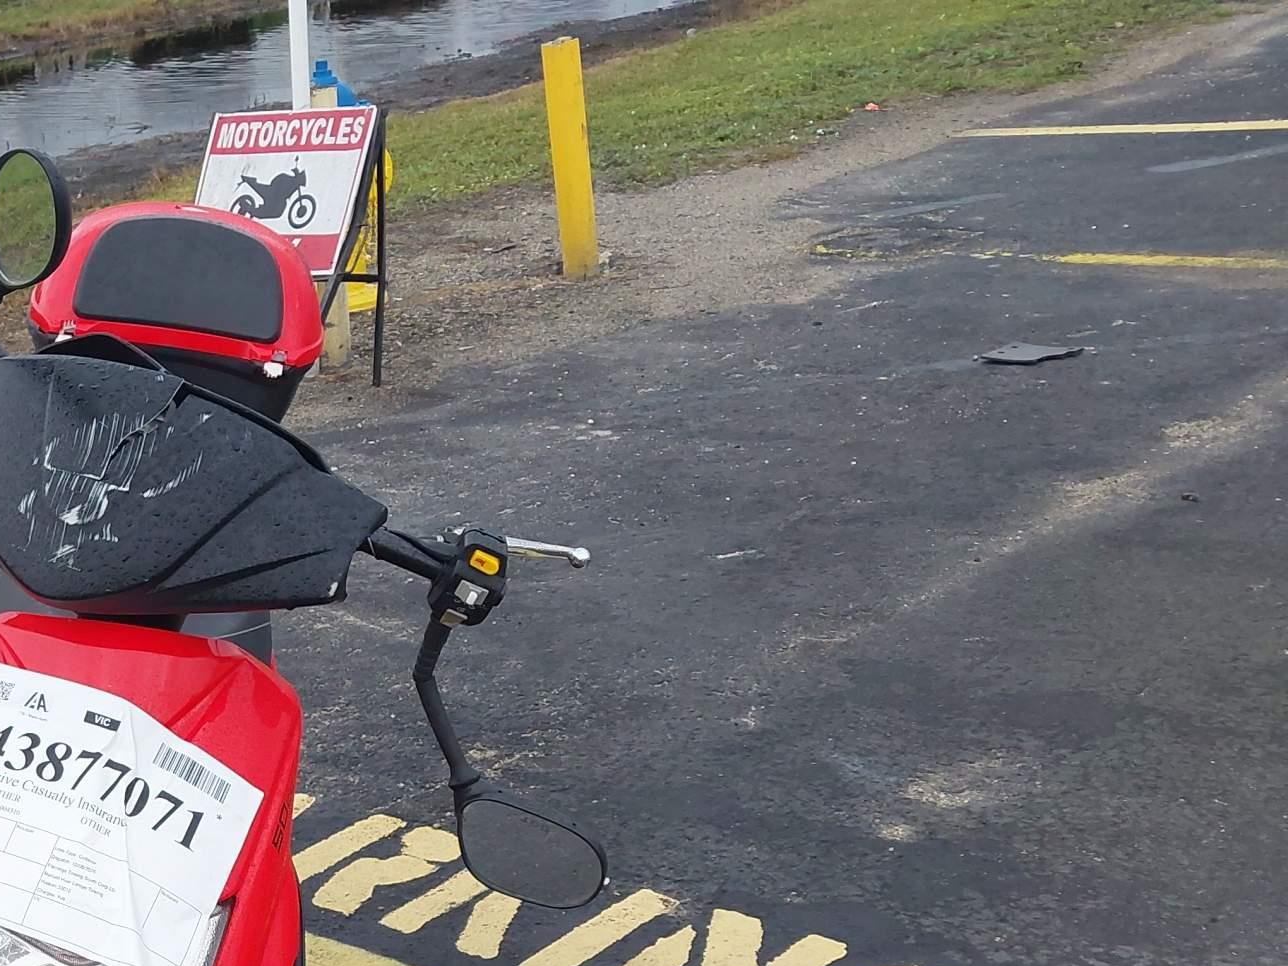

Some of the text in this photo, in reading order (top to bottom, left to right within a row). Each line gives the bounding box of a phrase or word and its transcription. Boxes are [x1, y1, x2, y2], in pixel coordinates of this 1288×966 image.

[216, 116, 366, 149] MOTORCYCLES
[94, 714, 111, 727] VIC
[22, 779, 74, 809] Casualty
[80, 816, 112, 838] OTHER
